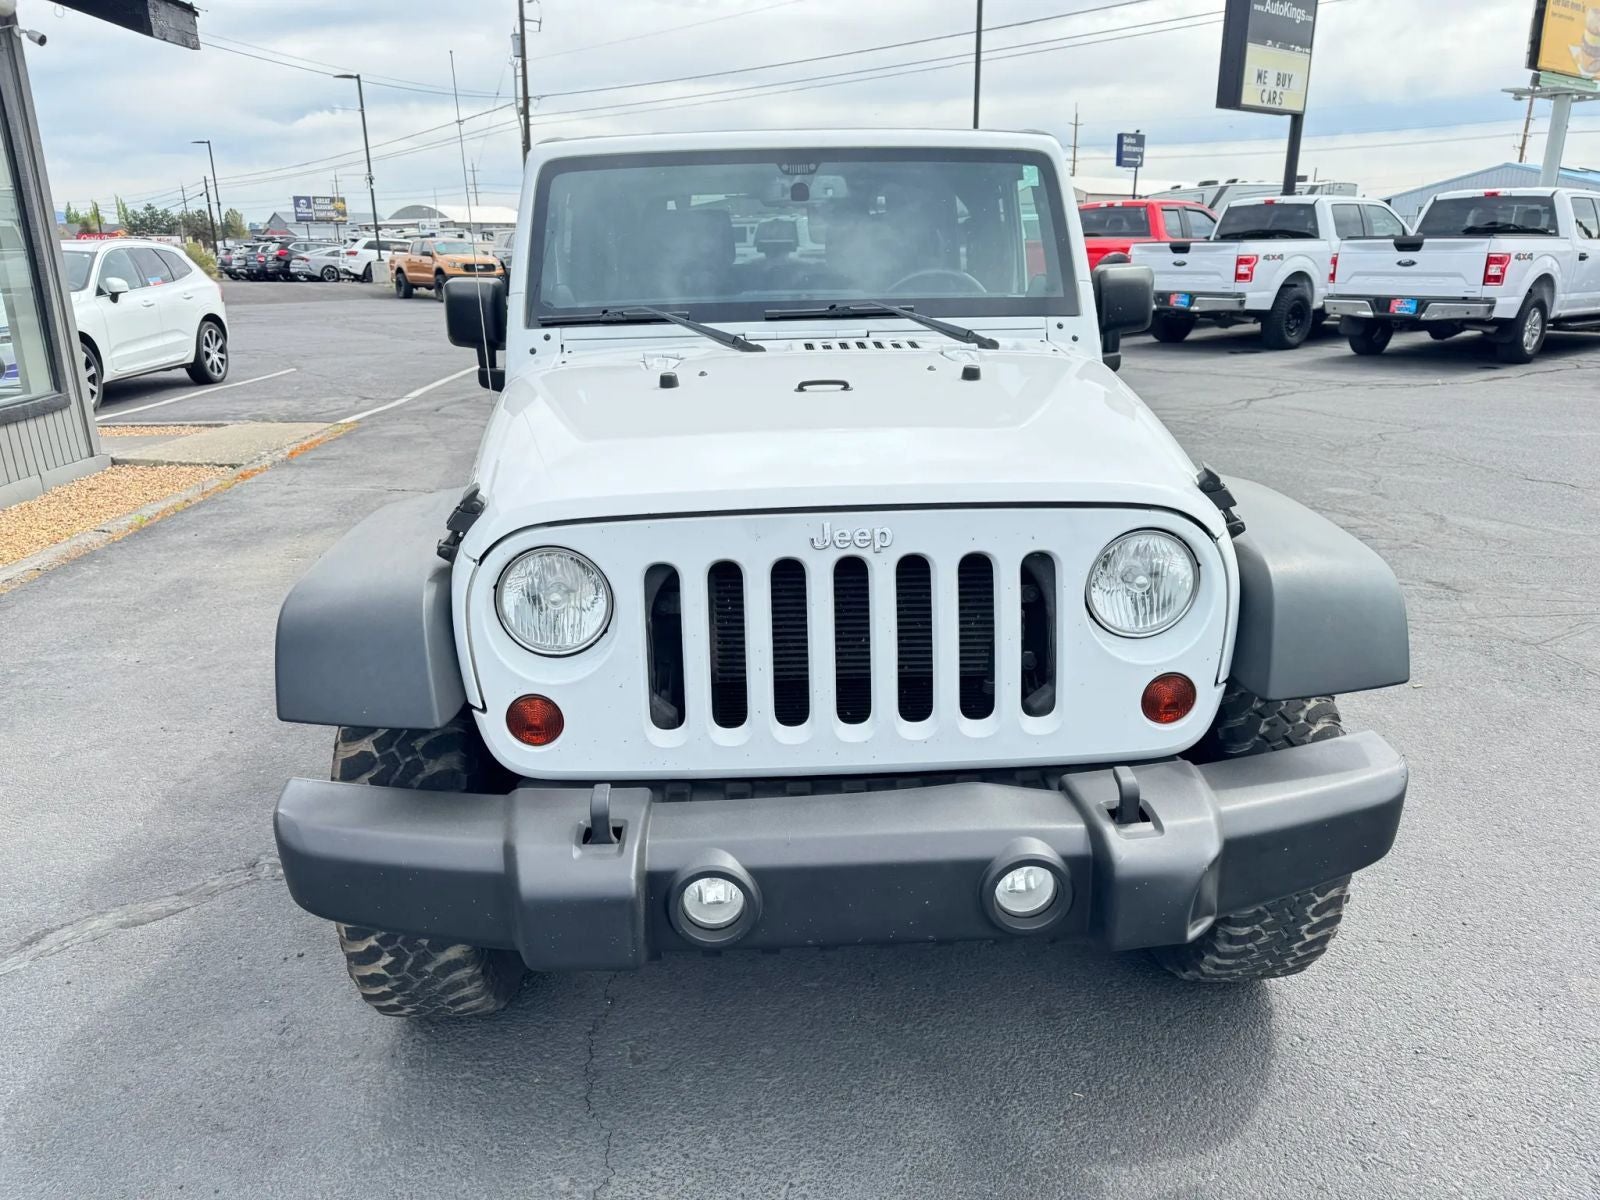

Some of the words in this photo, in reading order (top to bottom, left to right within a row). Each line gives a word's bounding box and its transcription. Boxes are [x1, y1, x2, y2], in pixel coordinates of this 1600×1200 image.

[1276, 72, 1293, 88] BUY
[1260, 89, 1284, 106] CARS
[809, 521, 893, 553] Jeep
